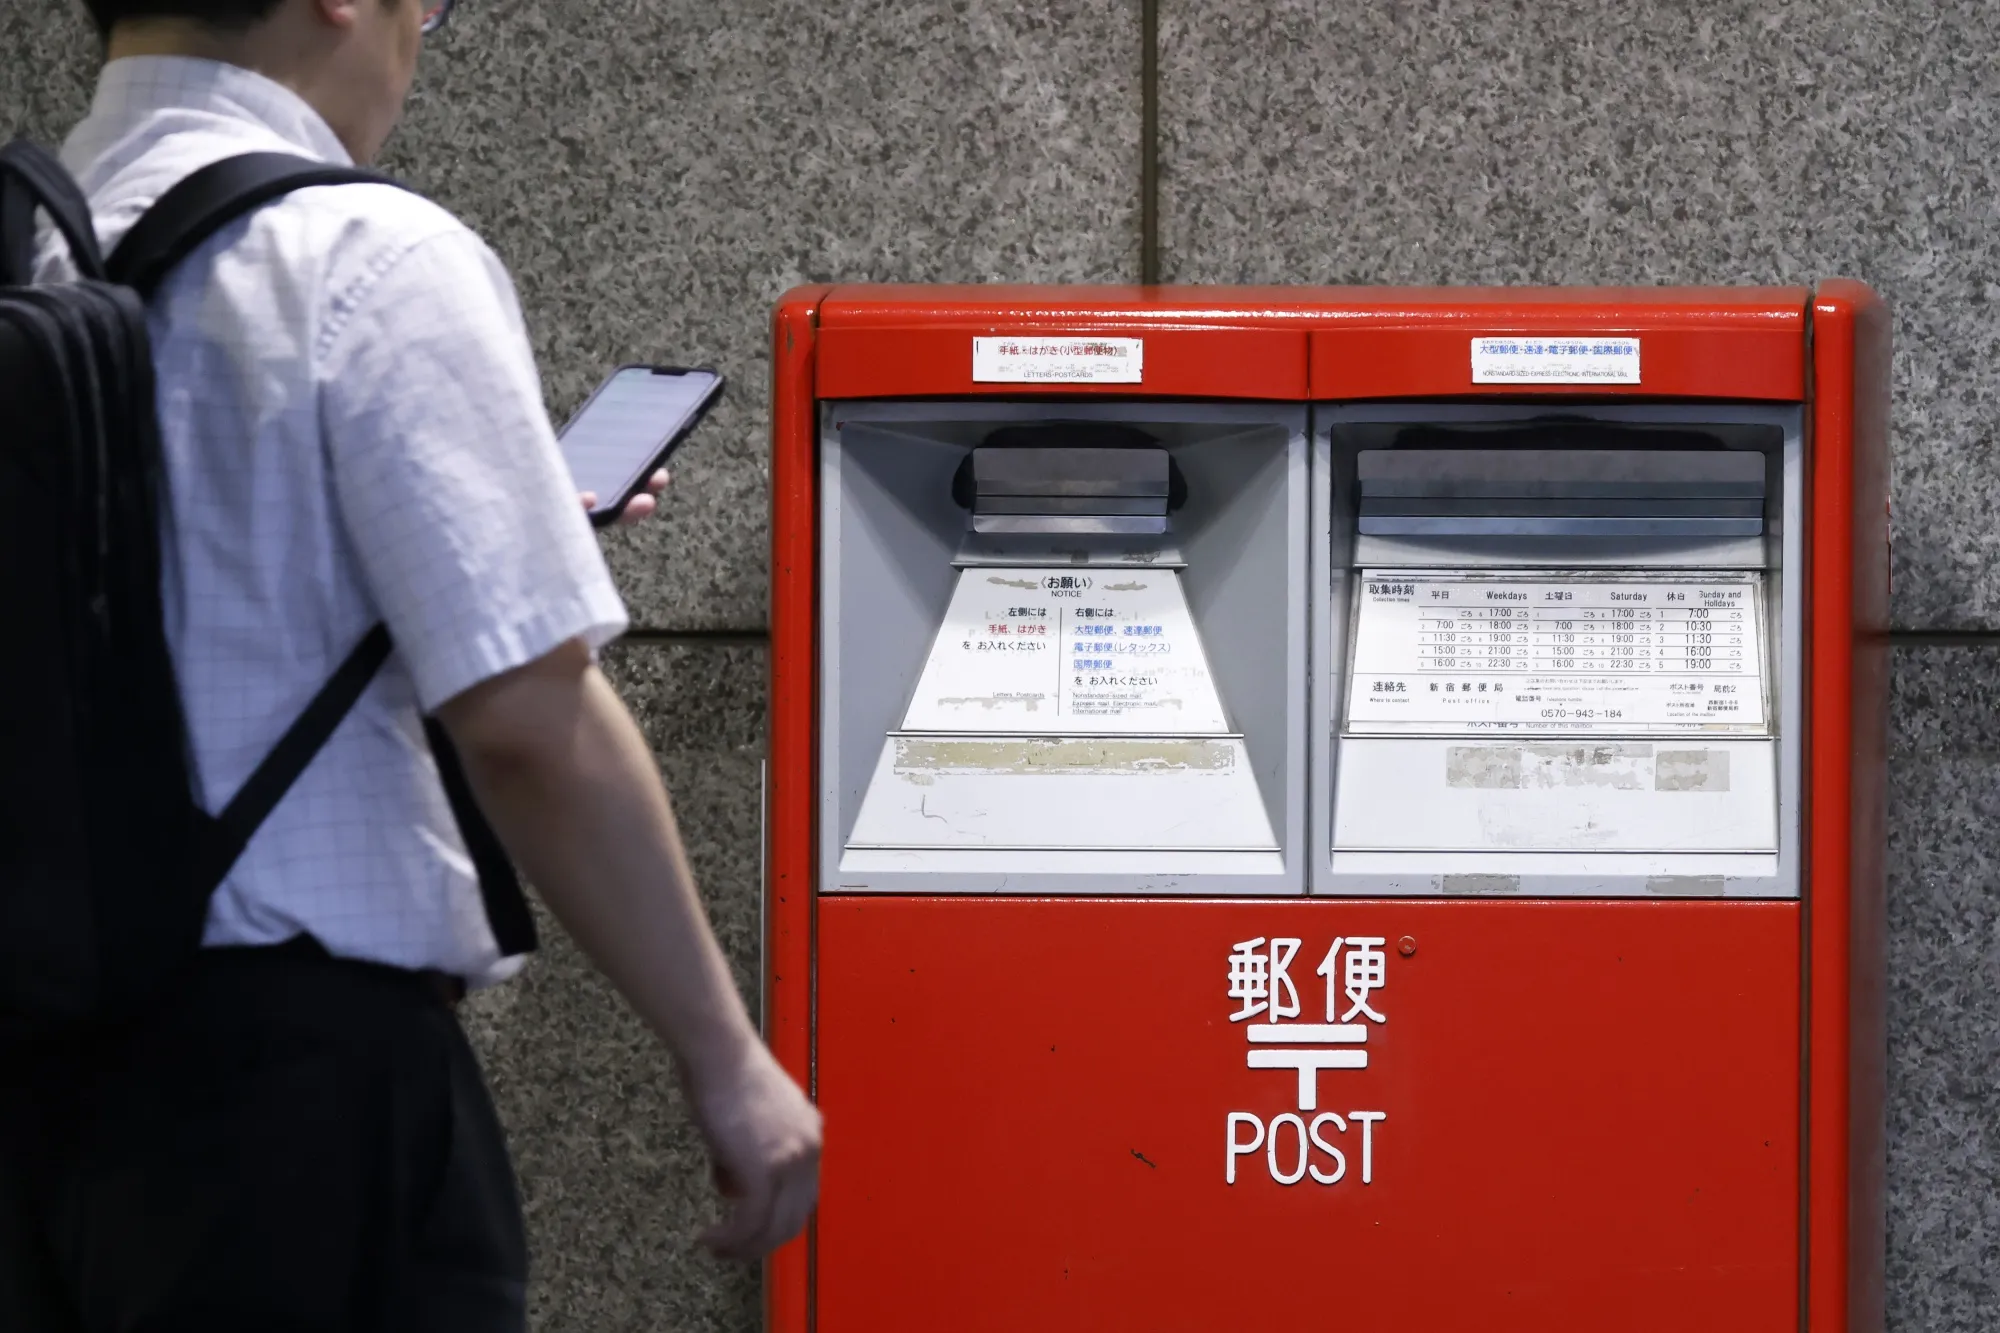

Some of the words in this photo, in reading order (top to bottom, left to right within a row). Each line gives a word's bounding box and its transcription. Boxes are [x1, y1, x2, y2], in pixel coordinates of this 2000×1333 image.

[1051, 590, 1082, 598] NOTICE
[1369, 584, 1415, 595] 取集時刻
[1431, 590, 1450, 599] 平日
[1486, 591, 1528, 601] Weekdays
[1545, 591, 1573, 600] 土曜日
[1610, 592, 1648, 602] Saturday
[1667, 592, 1685, 601] 休日
[1699, 590, 1726, 600] Sunday
[1728, 590, 1742, 598] and
[1704, 599, 1736, 608] Holidays
[1008, 607, 1047, 617] 左側には
[1075, 607, 1114, 618] 右側には
[1489, 608, 1512, 617] 17:00
[1612, 609, 1634, 618] 17:00
[1639, 611, 1652, 619] ごろ
[1688, 608, 1709, 619] 7:00
[1729, 612, 1742, 620] ごろ
[988, 624, 1047, 634] 手紙、はがき
[1074, 625, 1163, 635] 大型郵便、速達郵便
[1436, 621, 1454, 629] 7:00
[1489, 621, 1512, 629] 18:00
[1555, 621, 1572, 630] 7:00
[1612, 621, 1634, 630] 18:00
[1685, 621, 1712, 631] 10:30
[1730, 624, 1742, 632] ごろ
[1434, 633, 1456, 642] 11:30
[1489, 633, 1511, 642] 19:00
[1552, 634, 1575, 643] 11:30
[1612, 634, 1634, 643] 19:00
[1659, 636, 1664, 644] 3
[1685, 634, 1712, 644] 11:30
[962, 641, 971, 650] を
[977, 641, 1046, 651] お入れください
[1434, 646, 1456, 654] 15:00
[1488, 646, 1511, 655] 21:00
[1552, 647, 1575, 655] 15:00
[1610, 647, 1634, 656] 21:00
[1685, 647, 1712, 657] 16:00
[1729, 649, 1742, 657] ごろ
[1073, 659, 1113, 669] 国際郵便
[1434, 658, 1456, 667] 16:00
[1488, 659, 1511, 667] 22:30
[1552, 659, 1574, 668] 16:00
[1610, 659, 1634, 668] 22:30
[1659, 661, 1663, 669] 5
[1685, 659, 1711, 669] 19:00
[1729, 662, 1742, 670] ごろ
[1074, 676, 1083, 685] を
[1089, 676, 1158, 686] お入れください
[1372, 681, 1407, 692] 連絡先
[1429, 682, 1504, 692] 新宿郵便局
[1669, 683, 1704, 691] ポスト番号
[1227, 936, 1387, 1024] 郵便
[1226, 1111, 1387, 1184] POST
